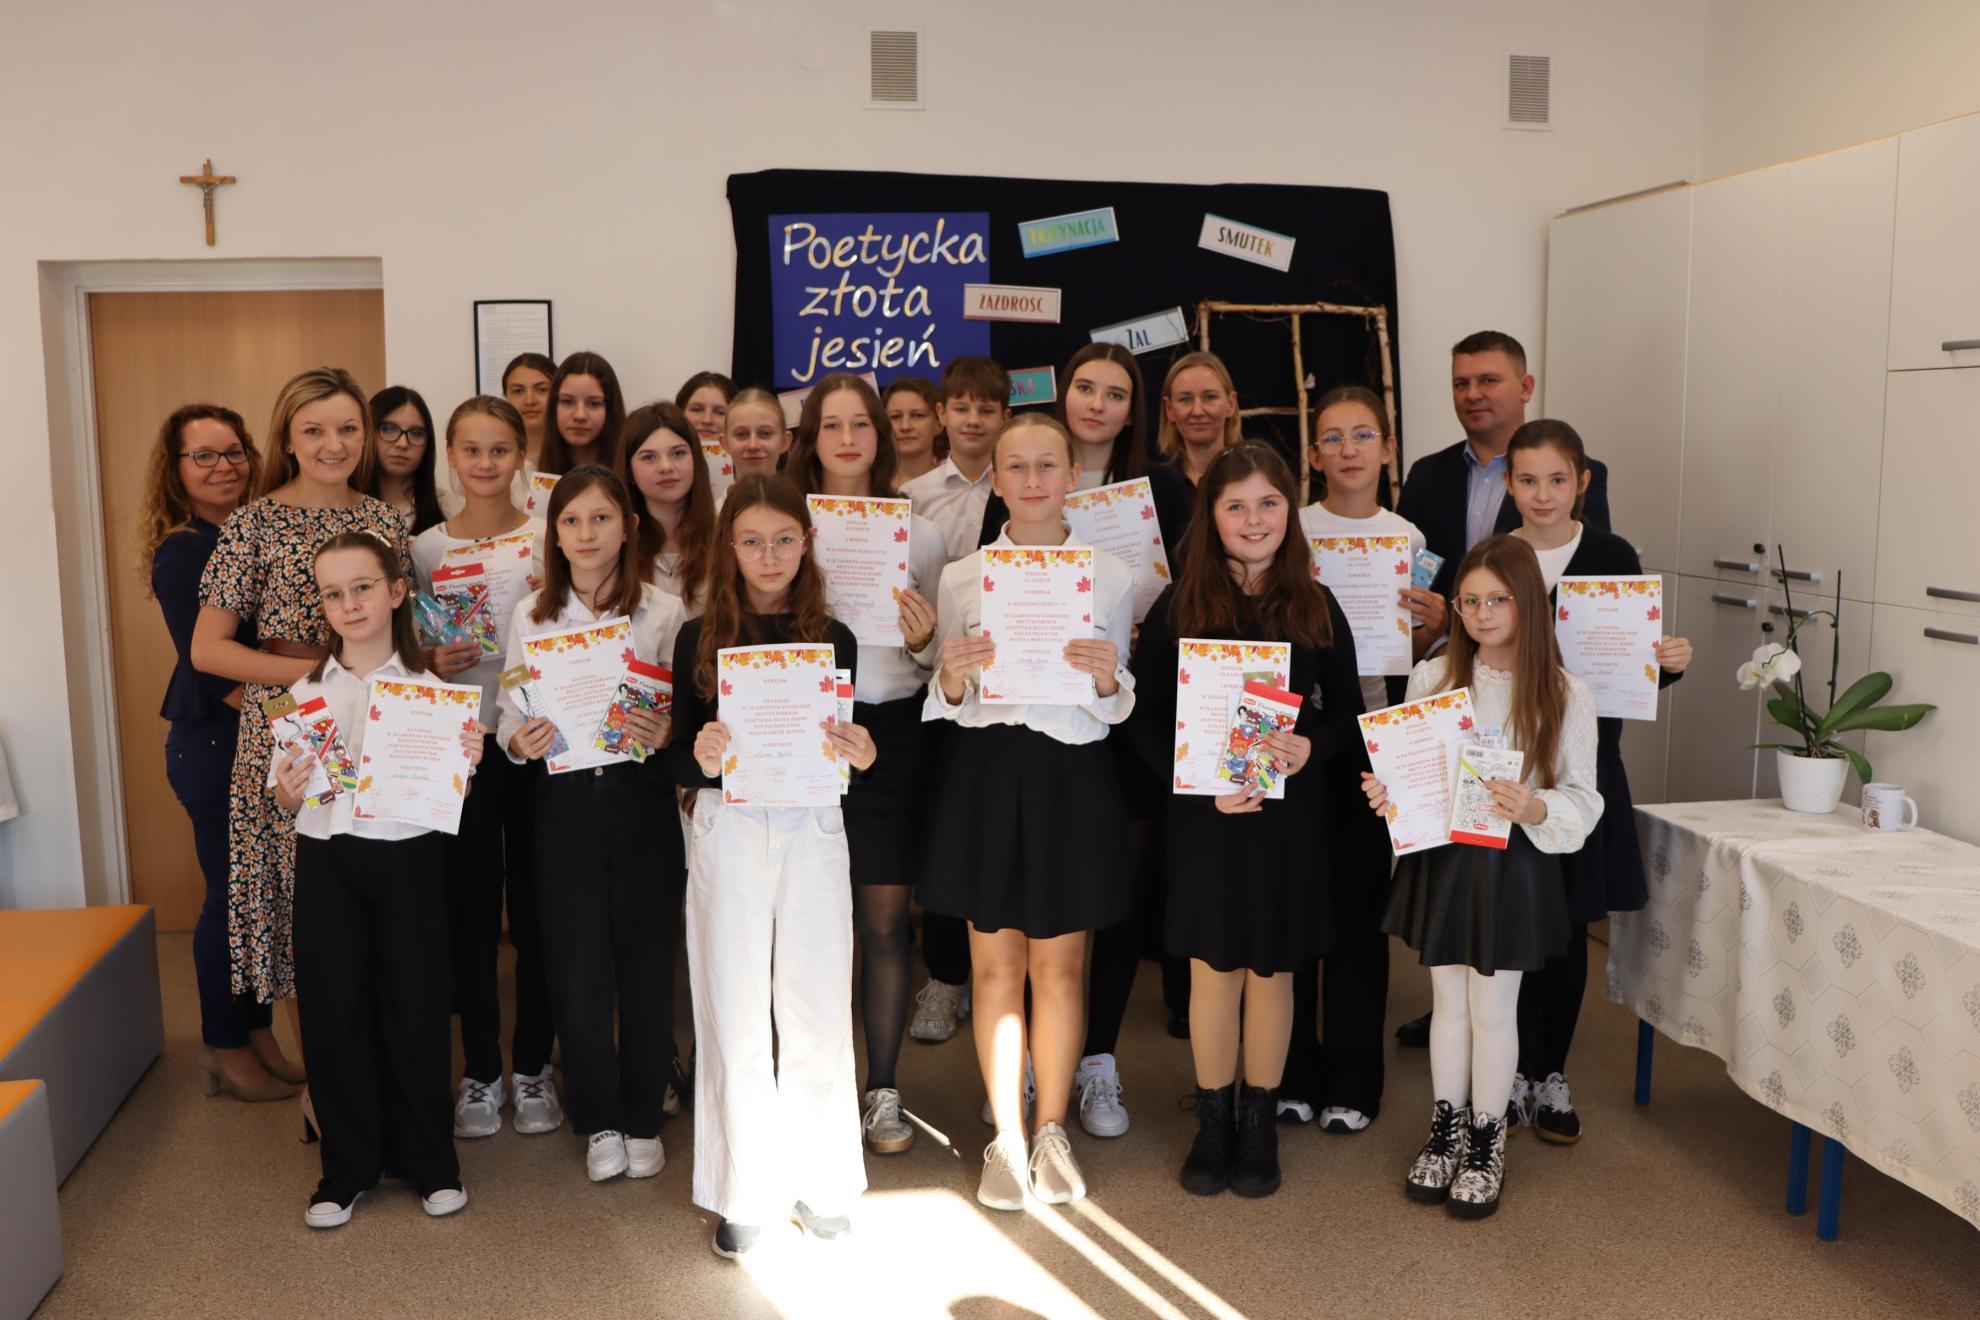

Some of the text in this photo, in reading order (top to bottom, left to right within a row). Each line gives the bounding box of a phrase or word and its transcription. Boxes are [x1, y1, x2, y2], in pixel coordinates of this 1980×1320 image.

[784, 218, 986, 277] Poetycka
[1218, 227, 1274, 257] SMUTEK
[798, 270, 932, 318] złota
[791, 323, 940, 382] jesień
